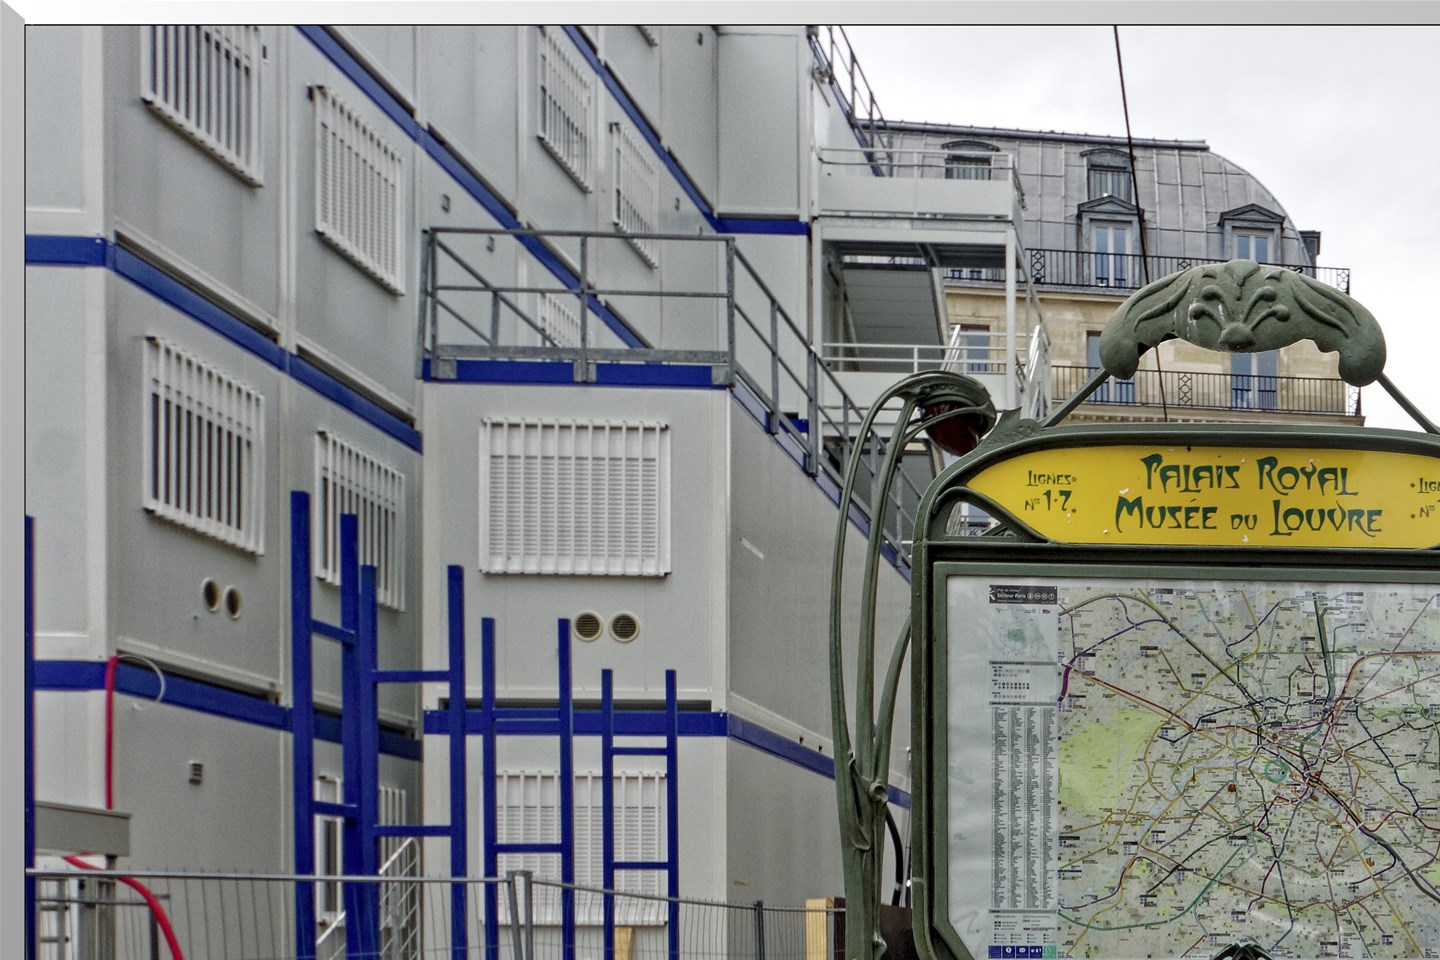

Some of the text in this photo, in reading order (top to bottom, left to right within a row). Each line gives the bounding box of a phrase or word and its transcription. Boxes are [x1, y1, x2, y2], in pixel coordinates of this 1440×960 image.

[1026, 470, 1072, 487] LIGNES
[1140, 453, 1359, 497] PALAIS ROYAL
[1115, 495, 1384, 537] MUSÉE DU LOUVRE
